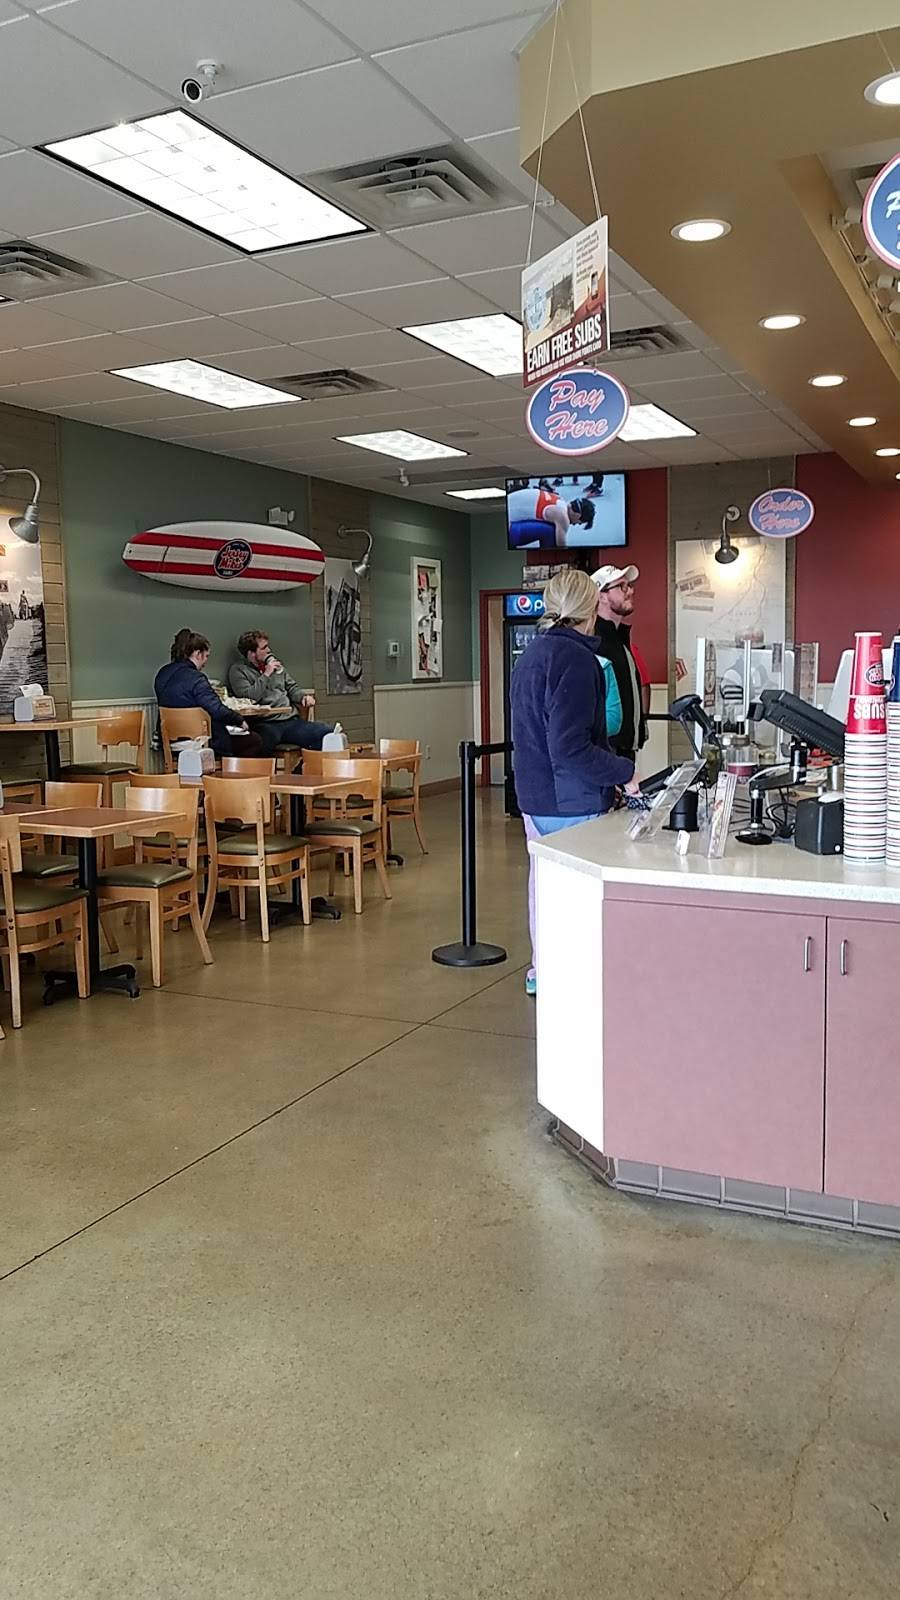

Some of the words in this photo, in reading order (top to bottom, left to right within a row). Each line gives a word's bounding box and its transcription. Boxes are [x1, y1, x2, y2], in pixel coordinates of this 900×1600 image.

[527, 340, 550, 373] EARN
[551, 328, 574, 361] FREE
[574, 314, 602, 348] SUBS
[549, 380, 605, 414] Pay
[545, 410, 609, 441] Here
[758, 495, 805, 514] Order
[220, 545, 249, 563] Jersey
[853, 703, 885, 720] SUBS
